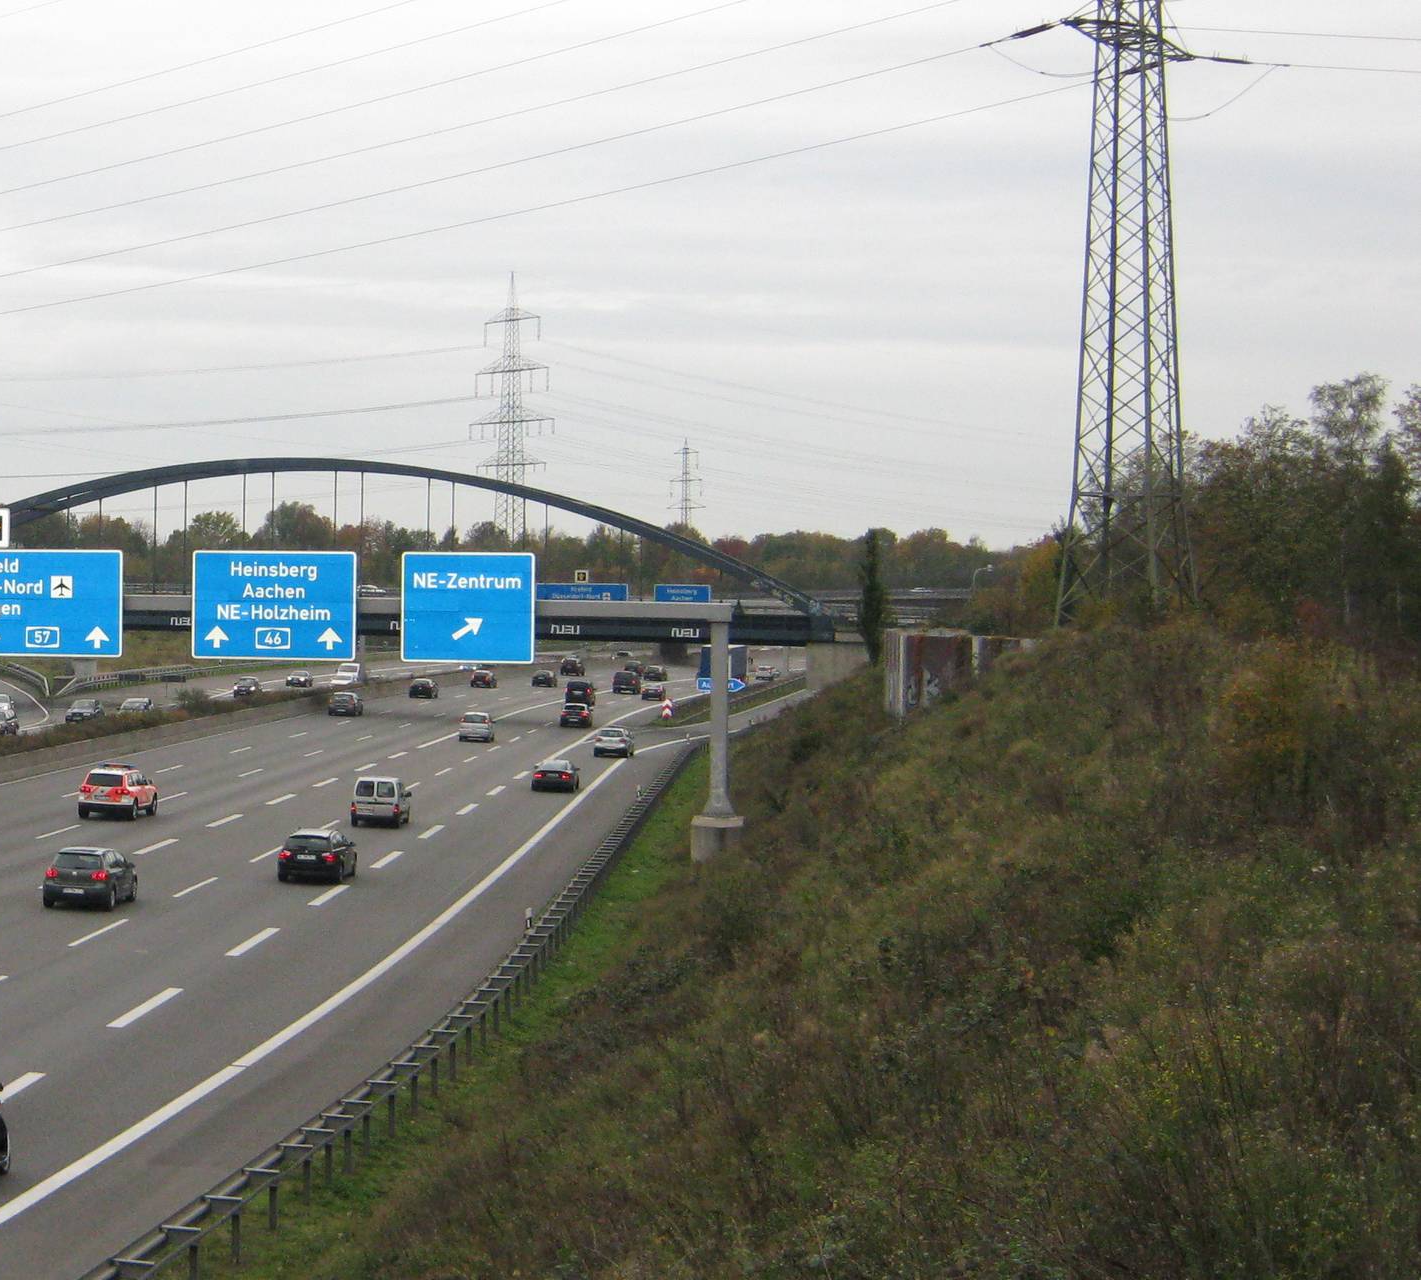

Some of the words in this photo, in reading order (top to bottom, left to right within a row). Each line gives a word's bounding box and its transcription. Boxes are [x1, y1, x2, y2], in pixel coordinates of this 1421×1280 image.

[230, 561, 317, 581] Heinsberg
[413, 572, 522, 589] NE-Zentrum
[242, 583, 305, 599] Aachen
[217, 604, 331, 620] NE-Holzheim
[34, 631, 51, 644] 57
[264, 632, 282, 645] 46
